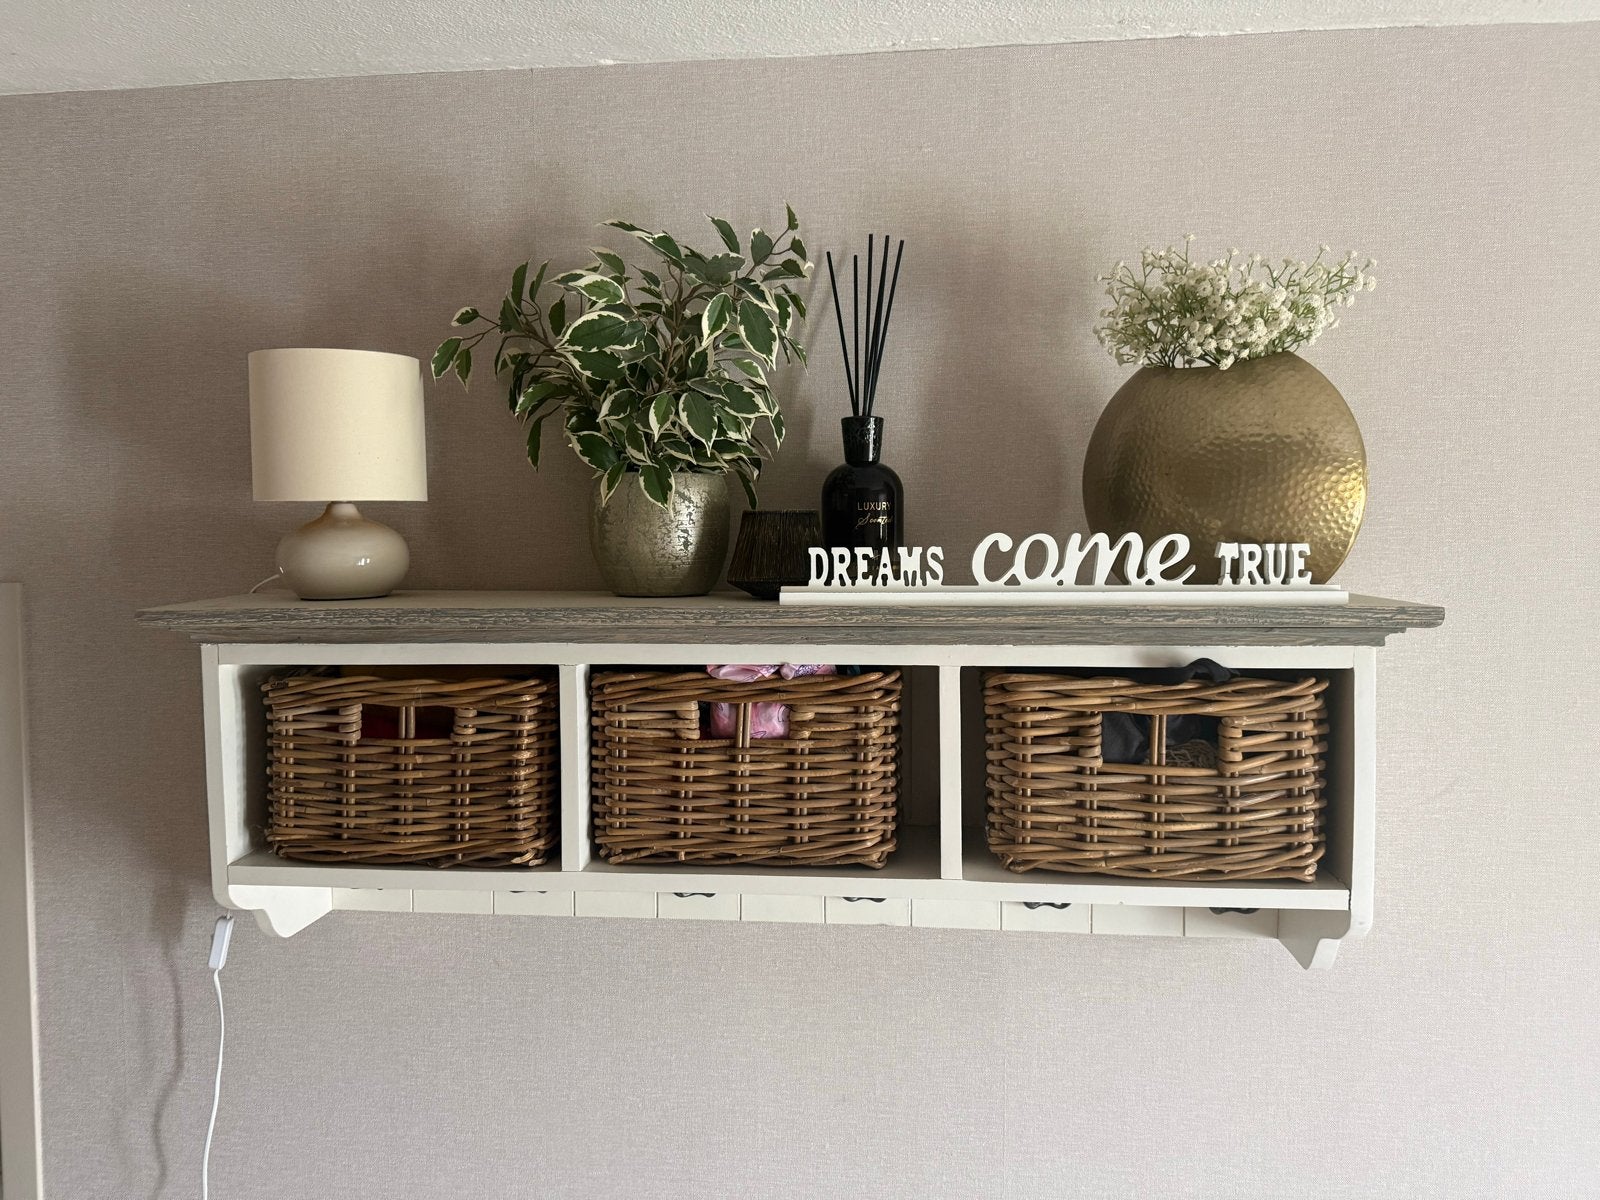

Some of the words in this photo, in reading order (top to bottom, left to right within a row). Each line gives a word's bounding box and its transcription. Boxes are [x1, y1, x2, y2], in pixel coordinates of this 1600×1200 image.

[857, 501, 892, 511] LUXURY
[808, 546, 945, 586] DREAMS
[972, 532, 1196, 586] come
[1218, 541, 1312, 586] TRUE
